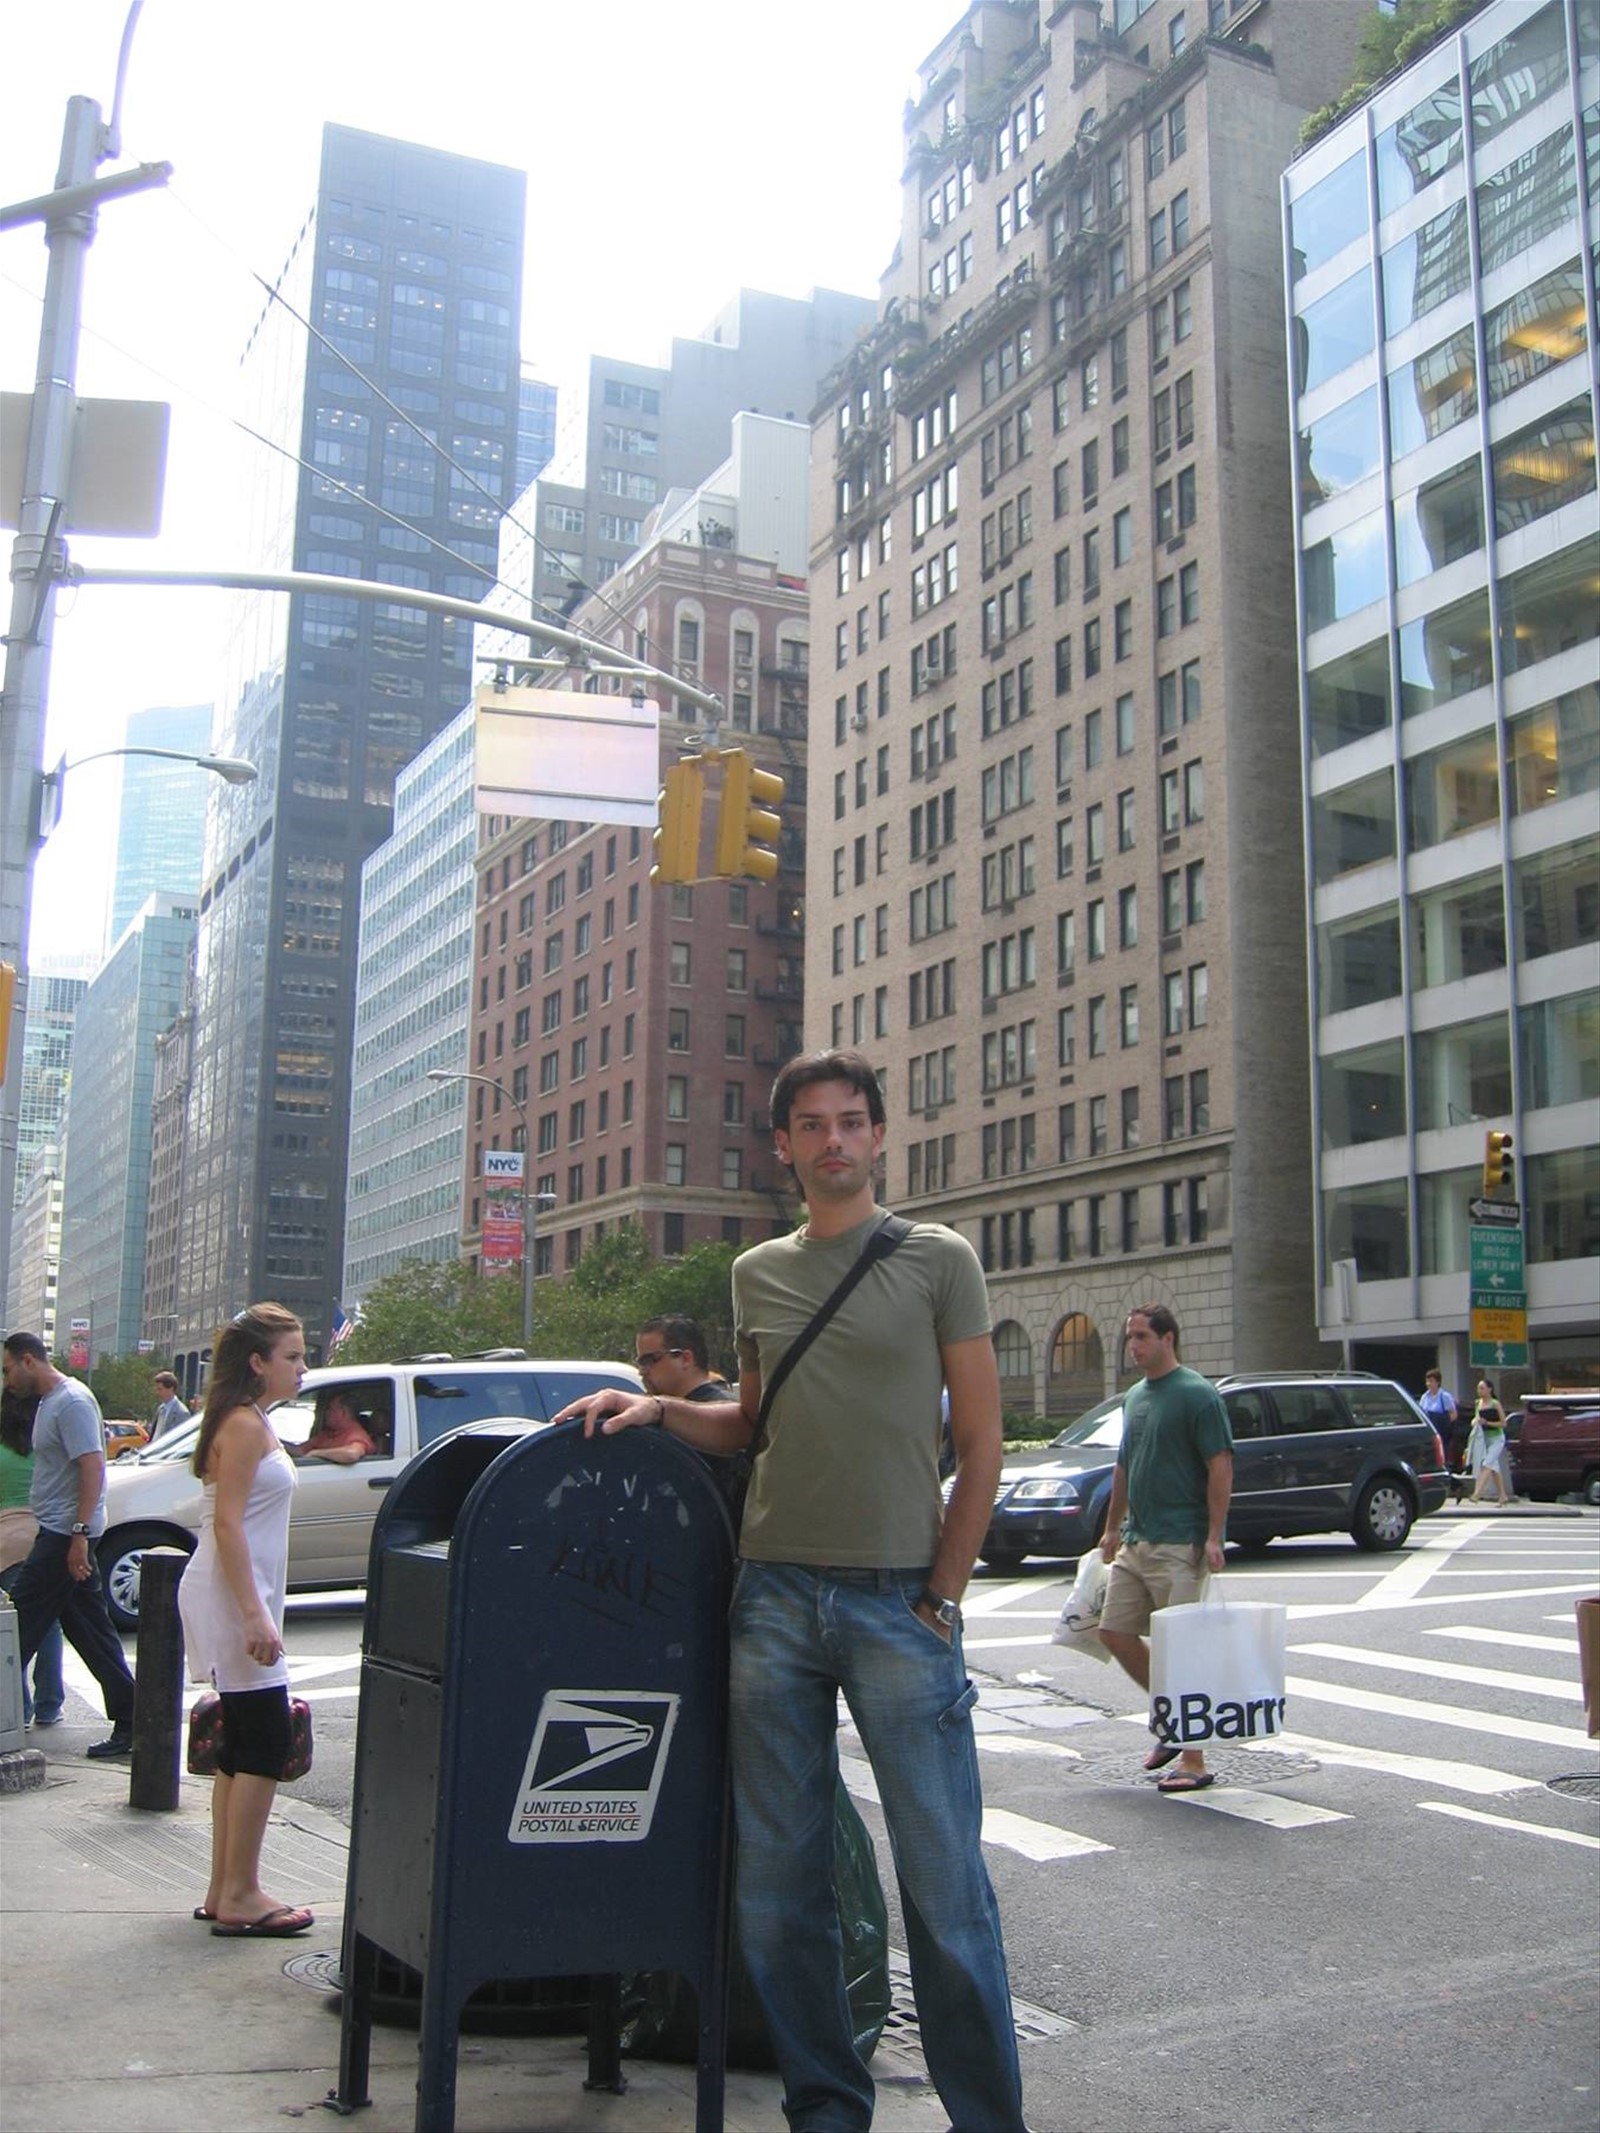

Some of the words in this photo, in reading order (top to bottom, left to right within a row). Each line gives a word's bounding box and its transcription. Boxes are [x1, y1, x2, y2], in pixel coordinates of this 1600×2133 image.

[488, 1159, 518, 1171] NYC
[1472, 1231, 1520, 1244] QUEENSBORO
[1483, 1246, 1510, 1258] BRIDGE
[1473, 1259, 1498, 1270] LOWER
[1477, 1295, 1492, 1306] ALT
[1494, 1296, 1522, 1308] ROUTE
[522, 1800, 582, 1815] UNITED
[584, 1800, 638, 1814] STATES
[518, 1819, 575, 1833] POSTAL
[578, 1818, 641, 1832] SERVICE
